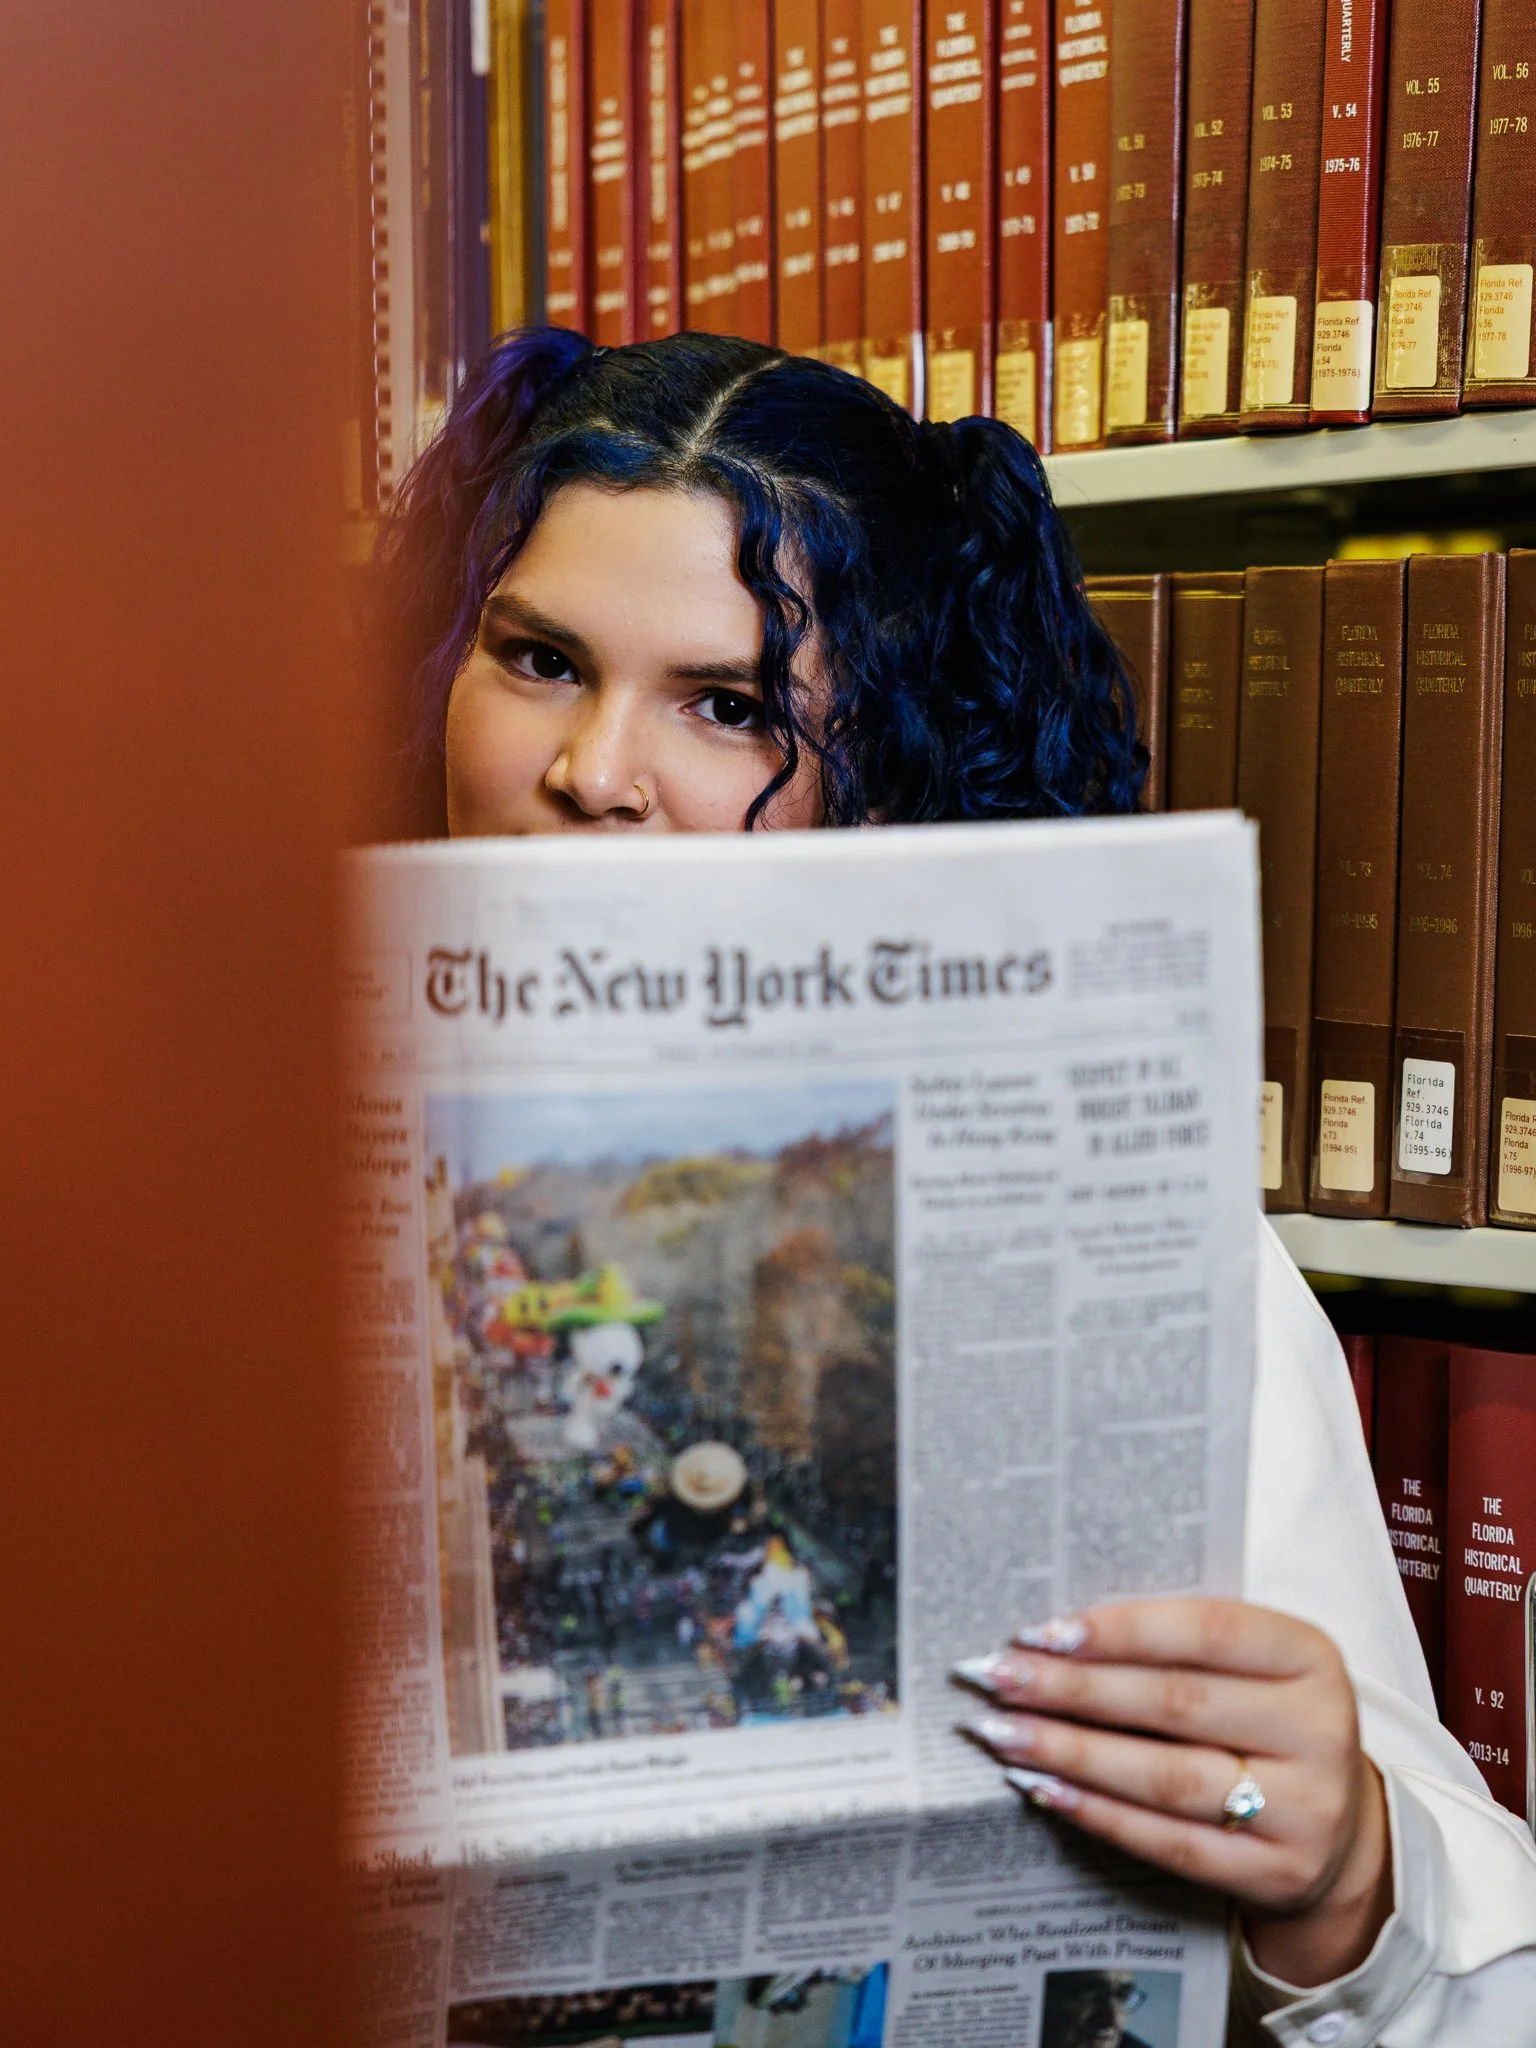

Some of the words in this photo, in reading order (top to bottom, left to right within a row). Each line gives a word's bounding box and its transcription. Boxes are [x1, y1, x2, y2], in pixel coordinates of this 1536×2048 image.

[1493, 65, 1512, 80] VOL.
[1516, 62, 1529, 78] 56
[1406, 80, 1424, 95] VOL.
[1428, 78, 1440, 93] 55
[1281, 103, 1292, 118] 53
[1333, 105, 1341, 118] V.
[1346, 104, 1357, 117] 54
[1490, 117, 1527, 134] 1977-78
[1403, 131, 1438, 148] 1976-77
[1260, 154, 1292, 172] 1974-75
[1325, 158, 1360, 173] 1975-76
[1480, 279, 1506, 288] Florida
[1480, 306, 1504, 314] Florida
[1318, 317, 1342, 326] Florida
[1317, 330, 1350, 339] 929.3746
[1316, 344, 1342, 352] Florida
[1342, 625, 1378, 640] FLORIDA
[1423, 624, 1459, 640] FLORIDA
[1416, 650, 1466, 666] HISTORICAL
[1336, 677, 1384, 695] QUARTERLY
[1416, 677, 1465, 694] QUARTERLY
[426, 946, 538, 1027] The
[557, 947, 686, 1014] New
[705, 944, 855, 1026] York
[867, 938, 1053, 1006] Times
[1408, 1074, 1444, 1088] Florida
[1324, 1093, 1348, 1103] Florida
[1406, 1088, 1424, 1100] Ref.
[1324, 1106, 1356, 1116] 929.3746
[1406, 1102, 1448, 1116] 929.3746
[1323, 1118, 1348, 1128] Florida
[1406, 1116, 1442, 1130] Florida
[1506, 1111, 1530, 1123] Florida
[1405, 1130, 1424, 1140] v.74
[1504, 1138, 1528, 1149] Florida
[1504, 1152, 1517, 1160] v.75
[1402, 1478, 1421, 1496] THE
[1482, 1497, 1502, 1515] THE
[1392, 1503, 1432, 1525] FLORIDA
[1472, 1522, 1514, 1545] FLORIDA
[1464, 1549, 1523, 1574] HISTORICAL
[1397, 1560, 1440, 1580] ARTERLY
[1464, 1576, 1522, 1602] QUARTERLY
[1475, 1688, 1484, 1704] V.
[1491, 1690, 1504, 1709] 92
[1469, 1741, 1509, 1765] 2013-14
